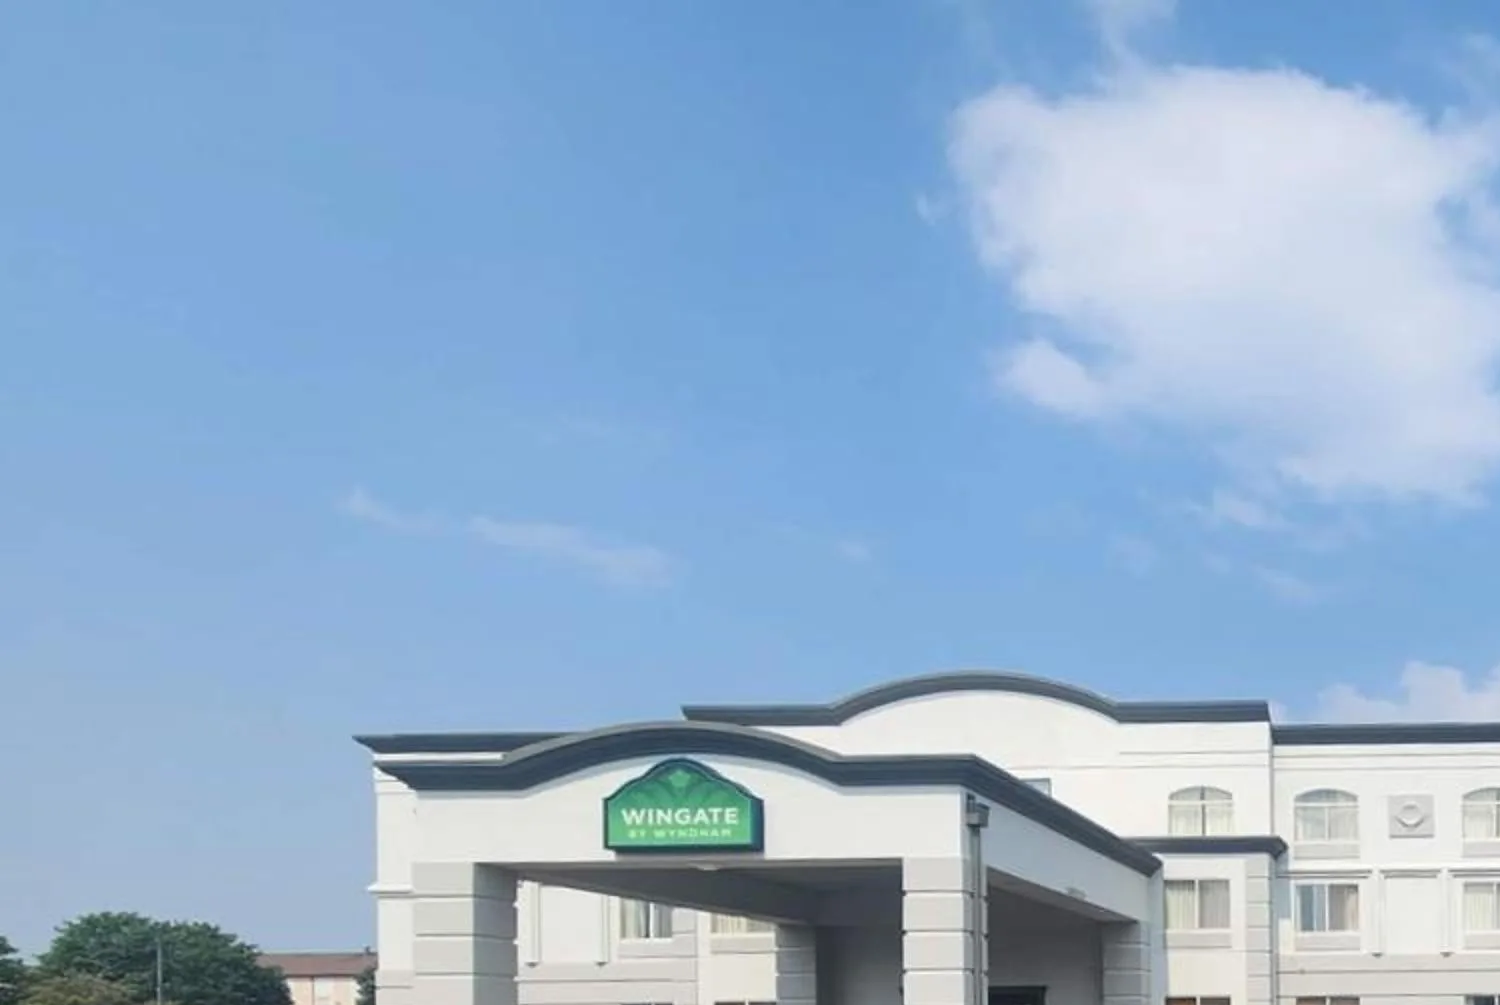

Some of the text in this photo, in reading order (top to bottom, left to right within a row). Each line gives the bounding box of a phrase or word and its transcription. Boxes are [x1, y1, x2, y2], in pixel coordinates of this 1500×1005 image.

[620, 807, 739, 825] WINGATE
[628, 828, 732, 839] BY WYNDHAM
